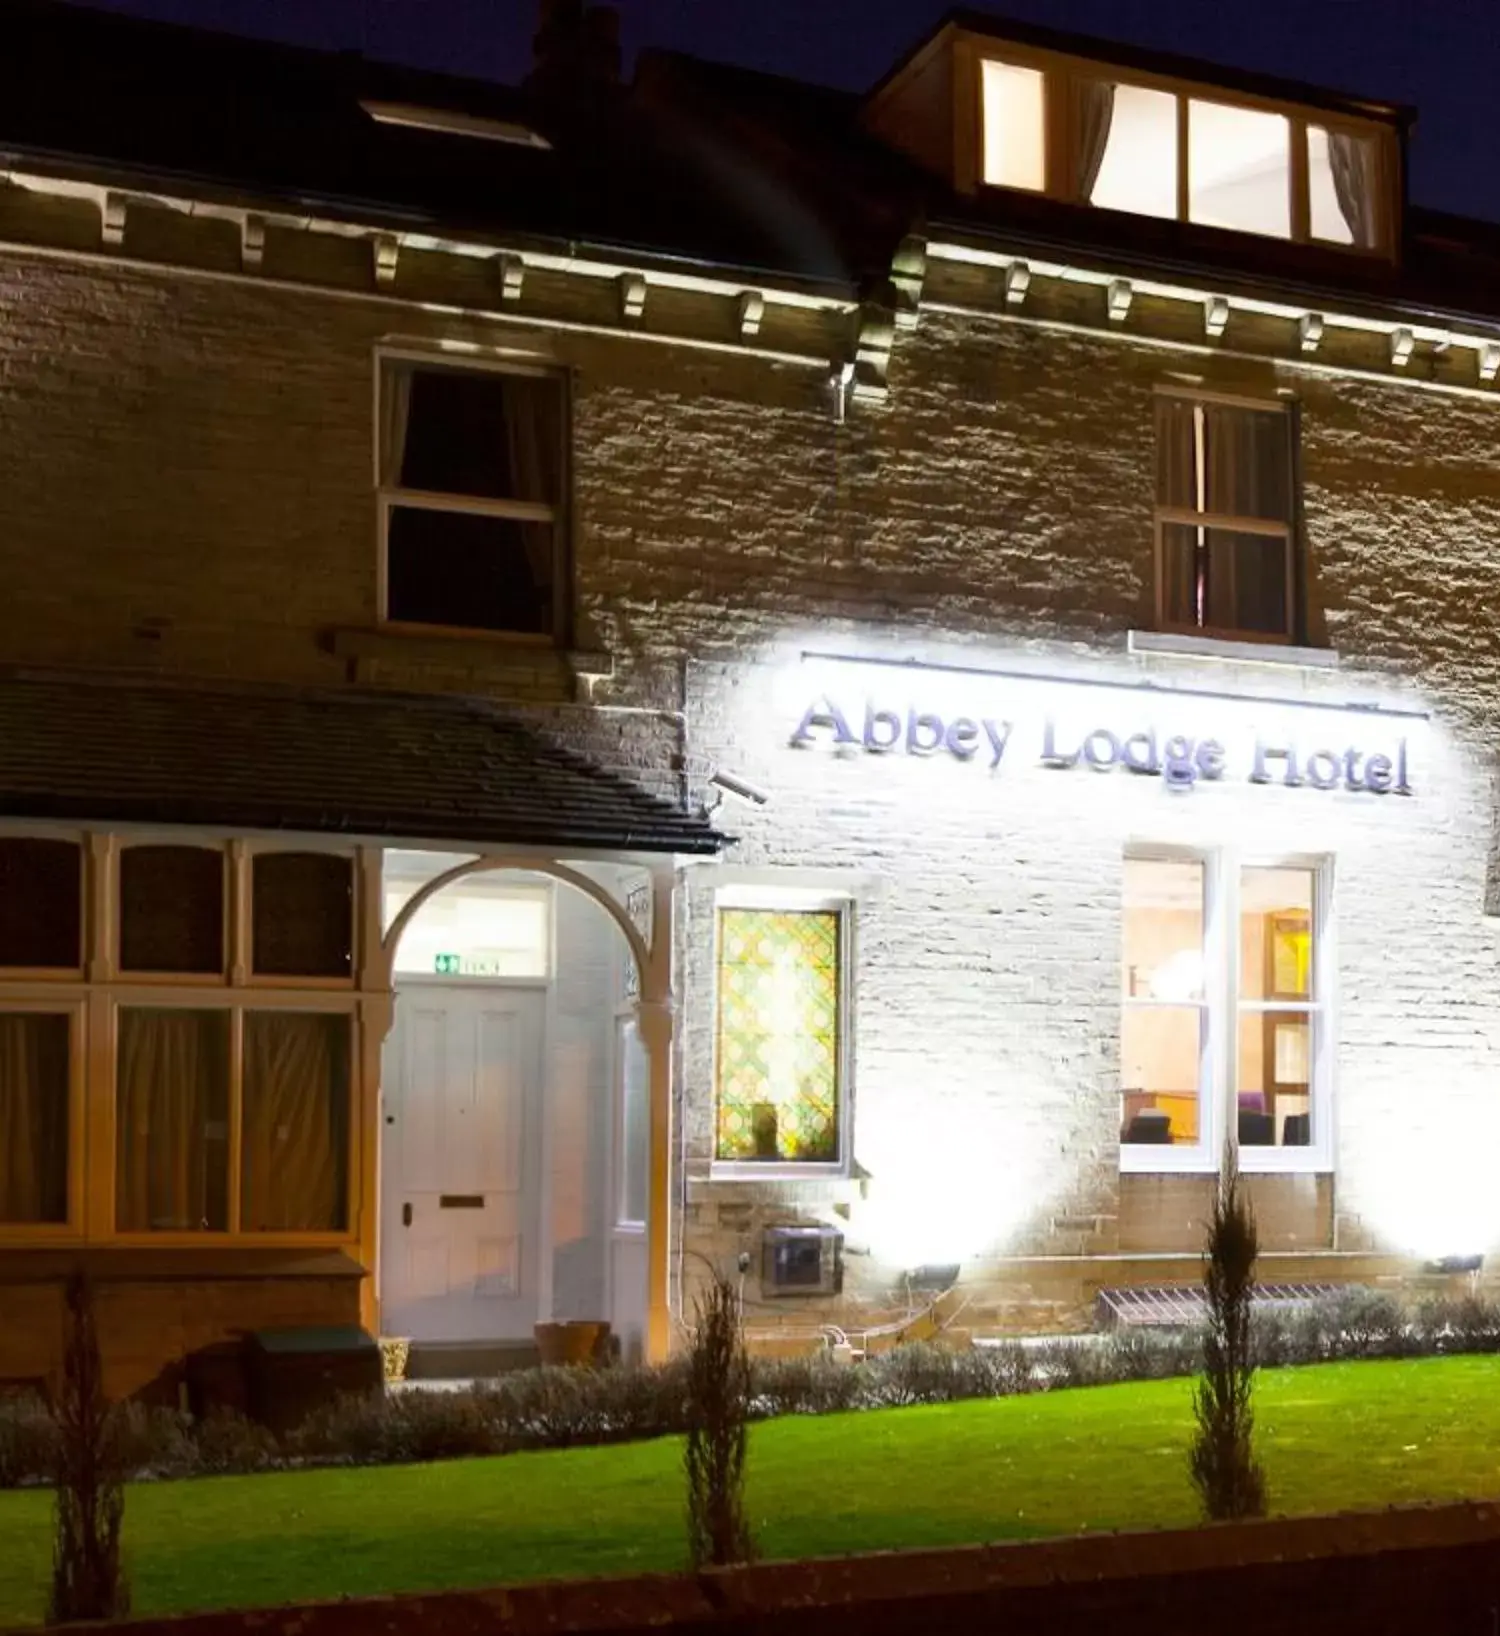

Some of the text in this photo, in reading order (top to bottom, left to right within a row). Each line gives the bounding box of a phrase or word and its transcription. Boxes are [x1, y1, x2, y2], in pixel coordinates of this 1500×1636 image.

[786, 693, 1415, 797] Abbey Lodge Hotel
